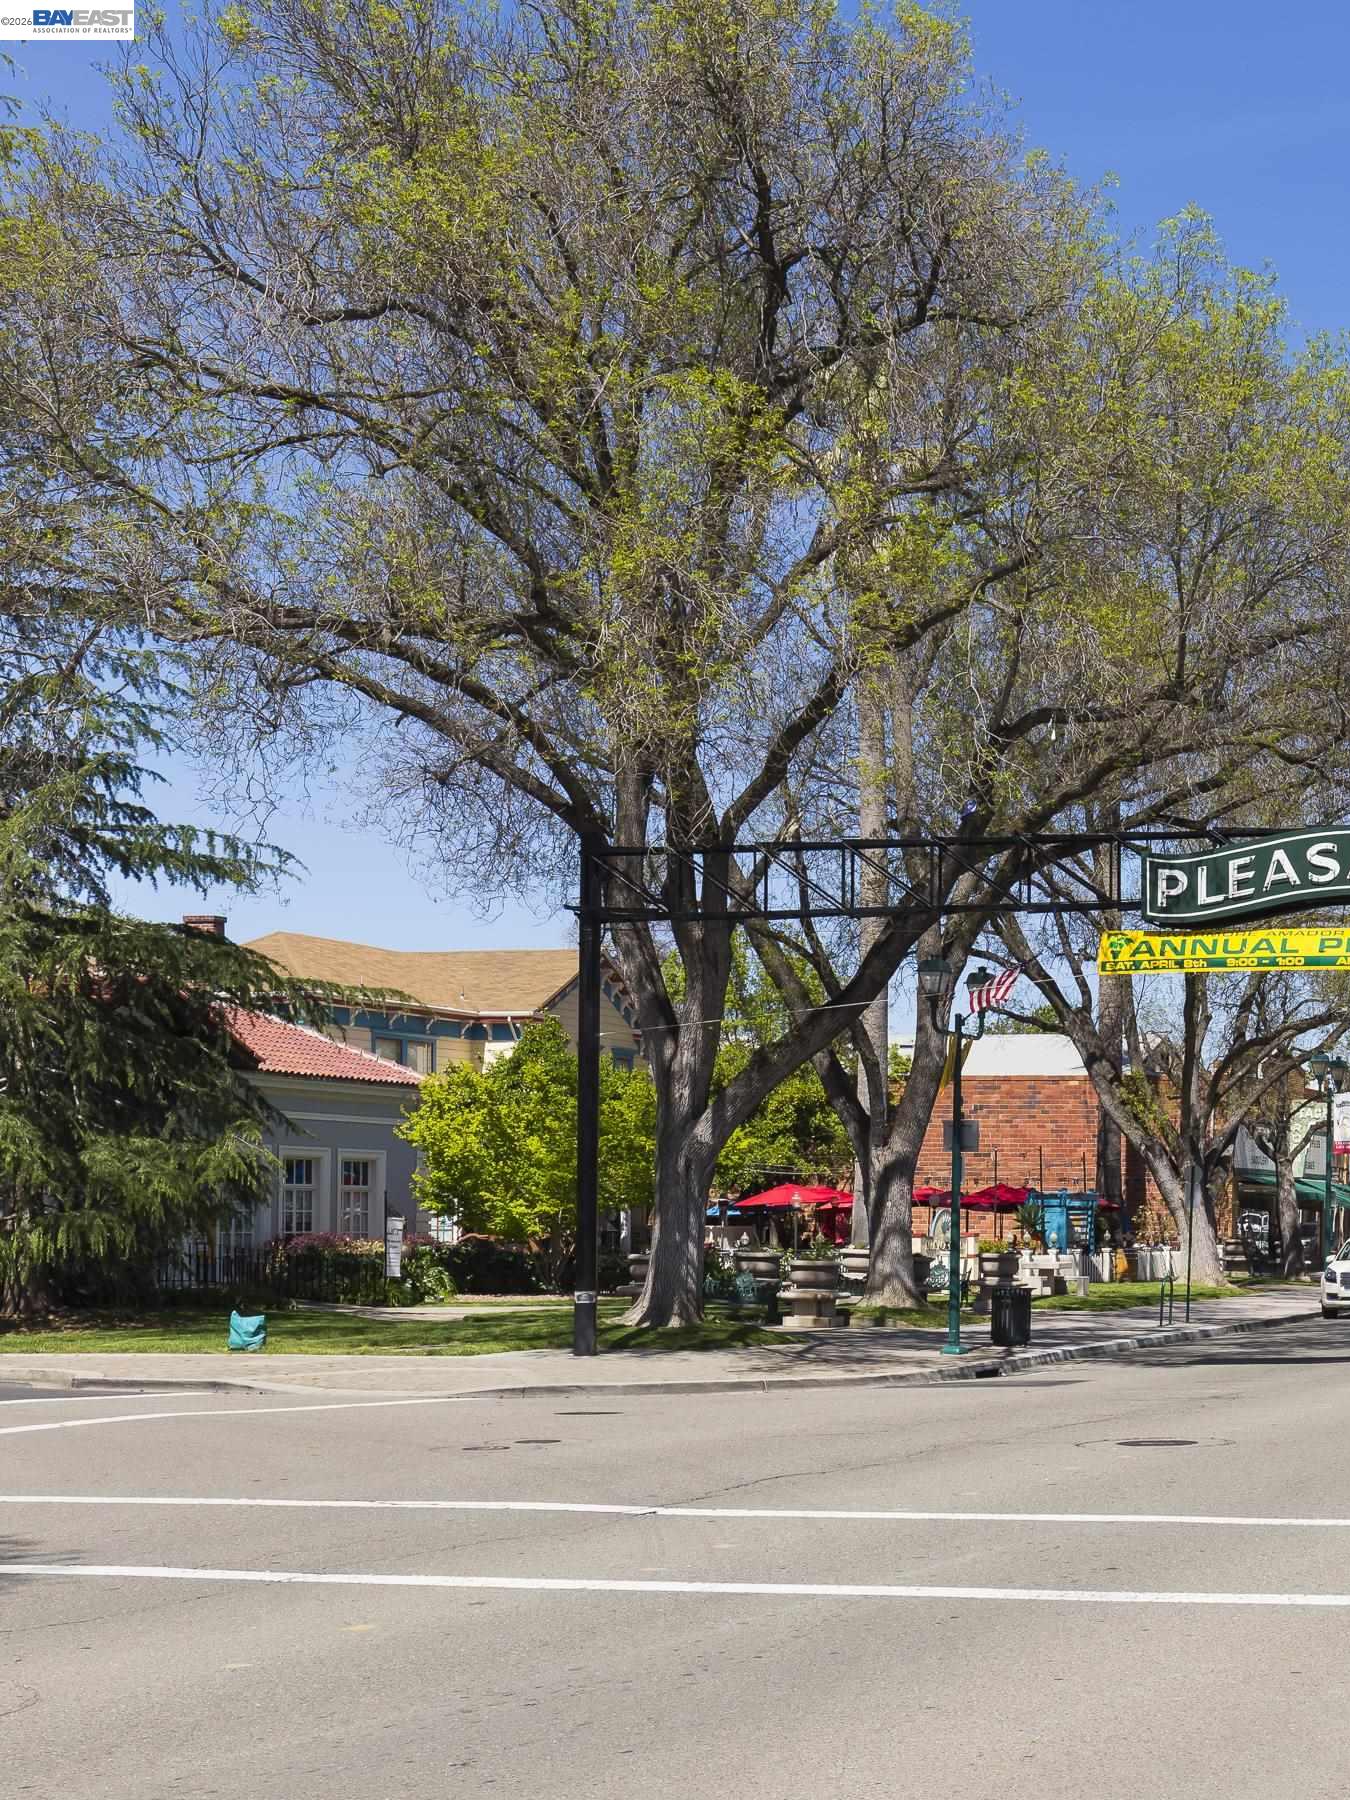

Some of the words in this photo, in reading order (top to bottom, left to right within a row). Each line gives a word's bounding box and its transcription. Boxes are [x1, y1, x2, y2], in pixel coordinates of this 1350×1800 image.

[1265, 929, 1345, 937] AMADOR
[1130, 937, 1300, 958] ANNUAL
[1105, 960, 1136, 971] SAT.
[1140, 959, 1180, 970] APRIL
[1226, 957, 1258, 967] 9:00
[1276, 956, 1305, 966] 1:00
